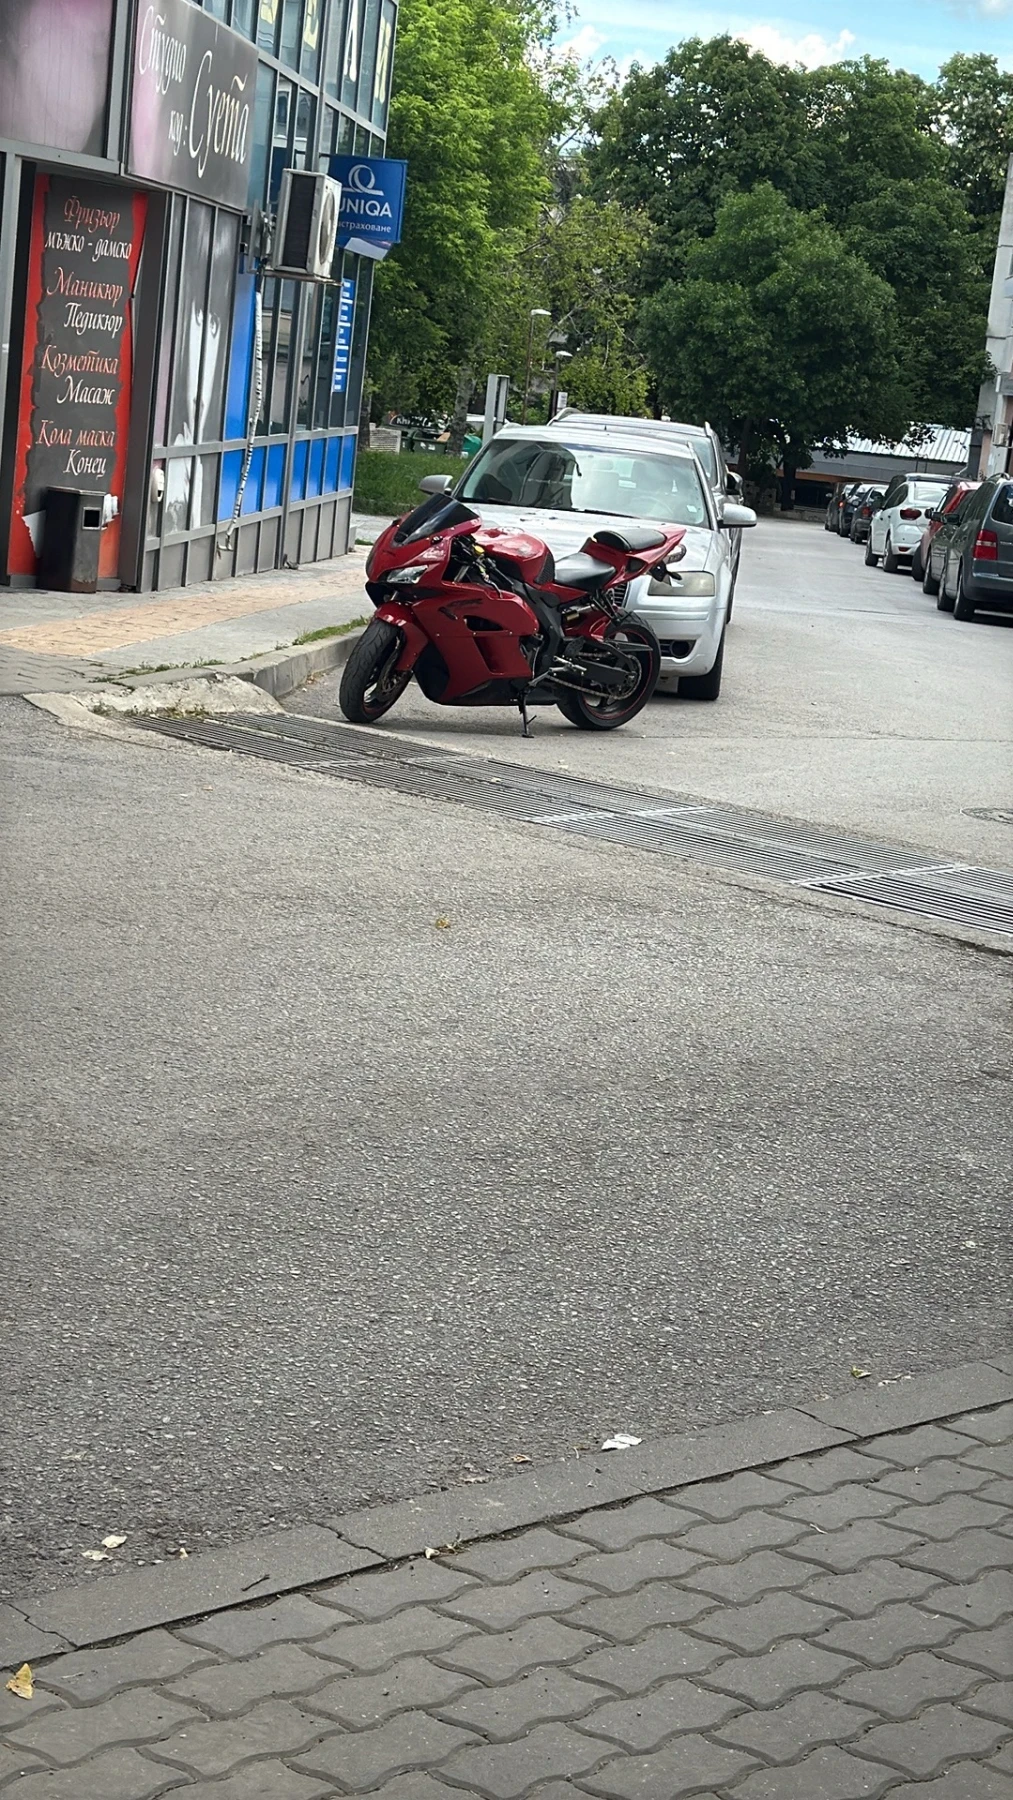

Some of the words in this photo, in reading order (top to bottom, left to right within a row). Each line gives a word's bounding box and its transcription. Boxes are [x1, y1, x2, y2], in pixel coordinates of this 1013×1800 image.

[139, 5, 187, 95] Студио
[189, 50, 249, 178] Суета
[64, 195, 120, 235] Фризьор
[339, 197, 392, 218] UNIQA
[45, 231, 85, 252] мъжко
[92, 238, 132, 262] дамско
[46, 266, 123, 308] Маникюр
[63, 302, 123, 339] Педикюр
[40, 344, 119, 378] Козметика
[56, 375, 115, 405] Масаж
[36, 419, 73, 447] Кола
[75, 429, 115, 447] маска
[63, 448, 107, 480] Конец
